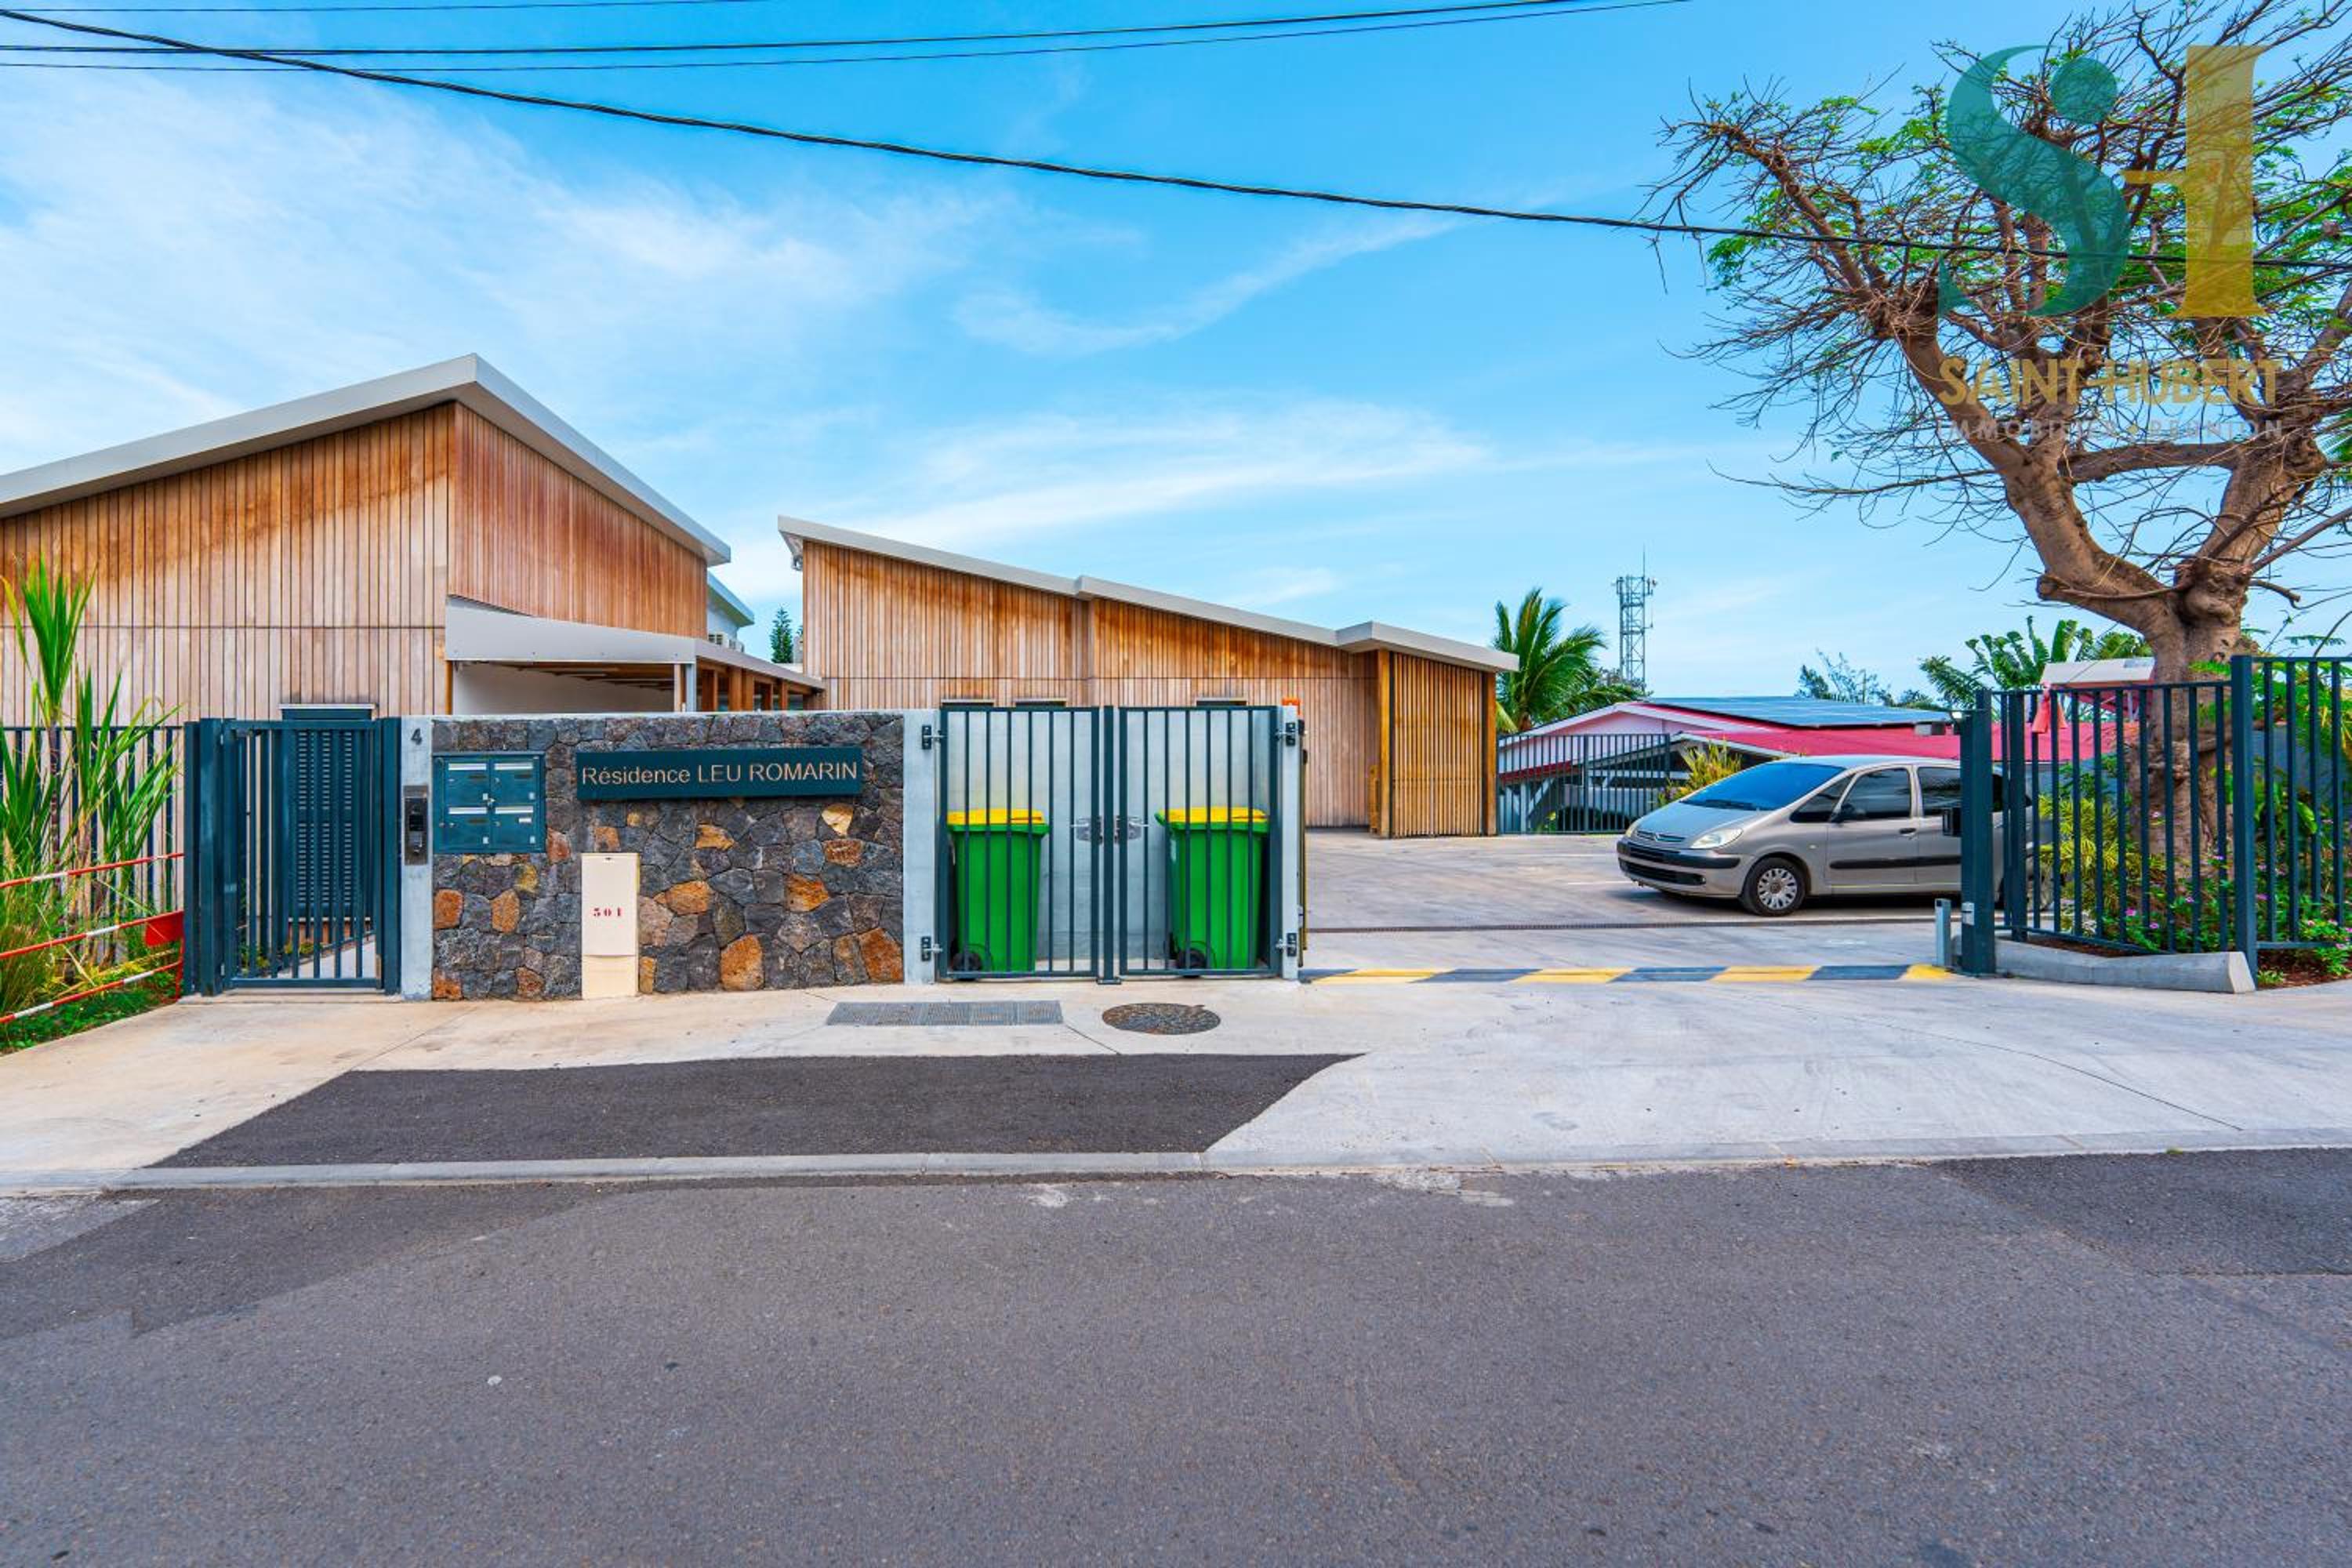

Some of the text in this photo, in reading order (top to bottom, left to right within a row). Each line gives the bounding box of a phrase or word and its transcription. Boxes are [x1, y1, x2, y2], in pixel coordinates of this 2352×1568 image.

[411, 728, 423, 746] 4
[582, 761, 858, 785] Résidence LEU ROMARIN
